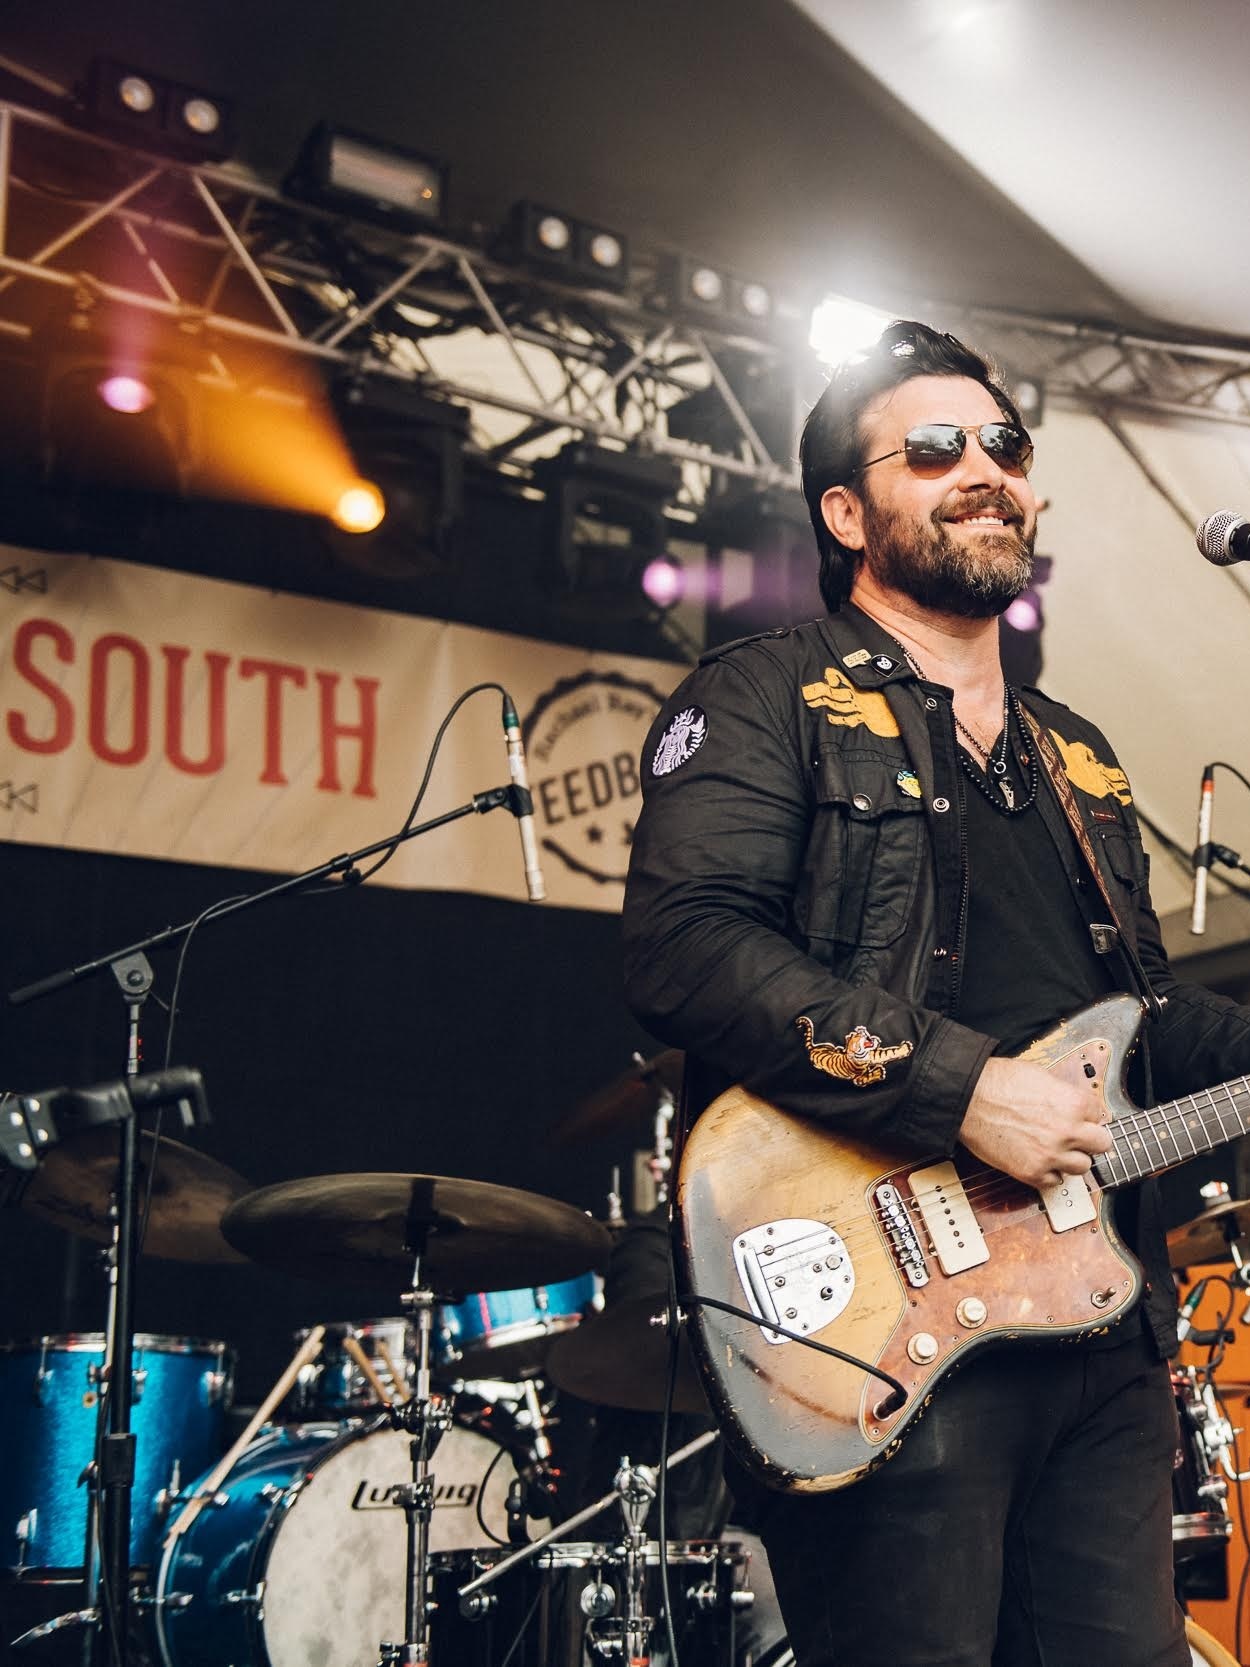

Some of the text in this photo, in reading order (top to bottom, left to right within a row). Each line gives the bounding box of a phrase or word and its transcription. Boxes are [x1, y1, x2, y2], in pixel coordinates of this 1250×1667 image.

[6, 617, 380, 798] SOUTH
[530, 751, 640, 825] EEDB
[351, 1480, 478, 1510] Luig
